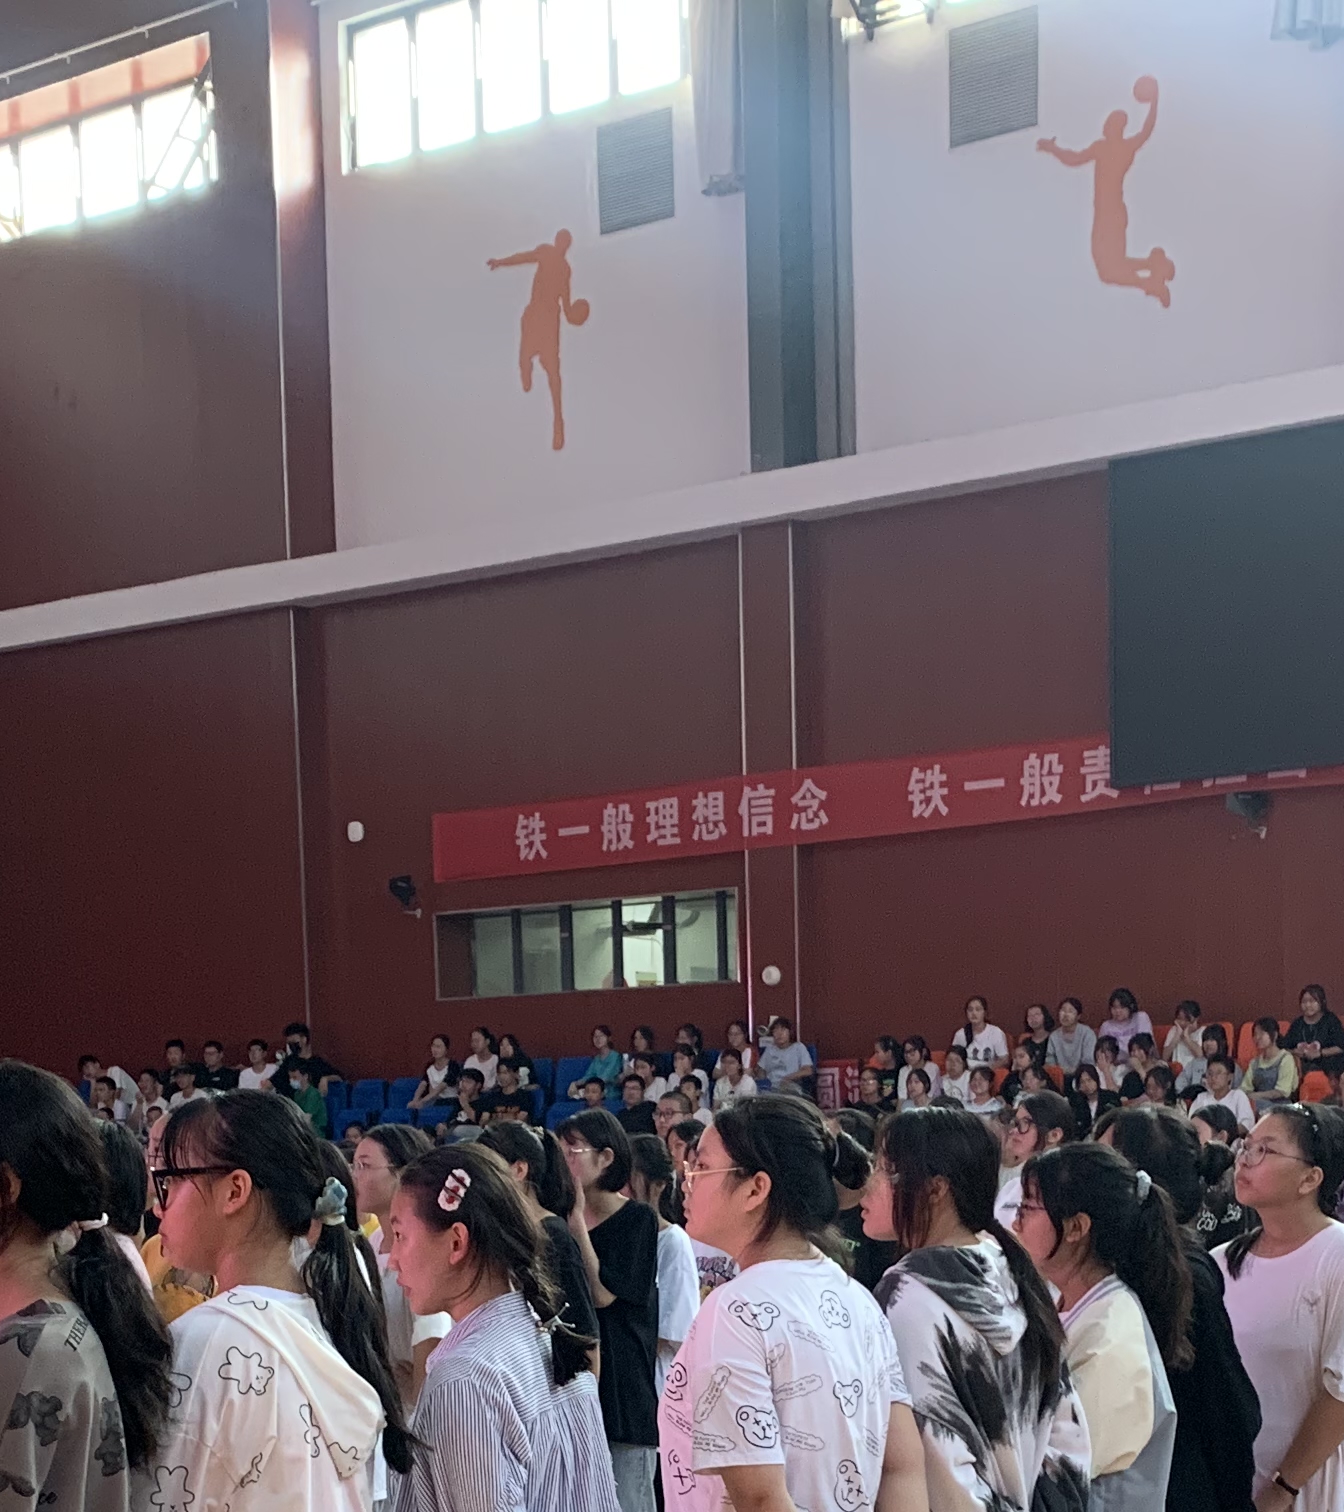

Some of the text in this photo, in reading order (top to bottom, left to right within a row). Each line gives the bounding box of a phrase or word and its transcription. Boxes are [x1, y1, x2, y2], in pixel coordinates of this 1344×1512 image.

[515, 778, 829, 862] 铁一般理想信念
